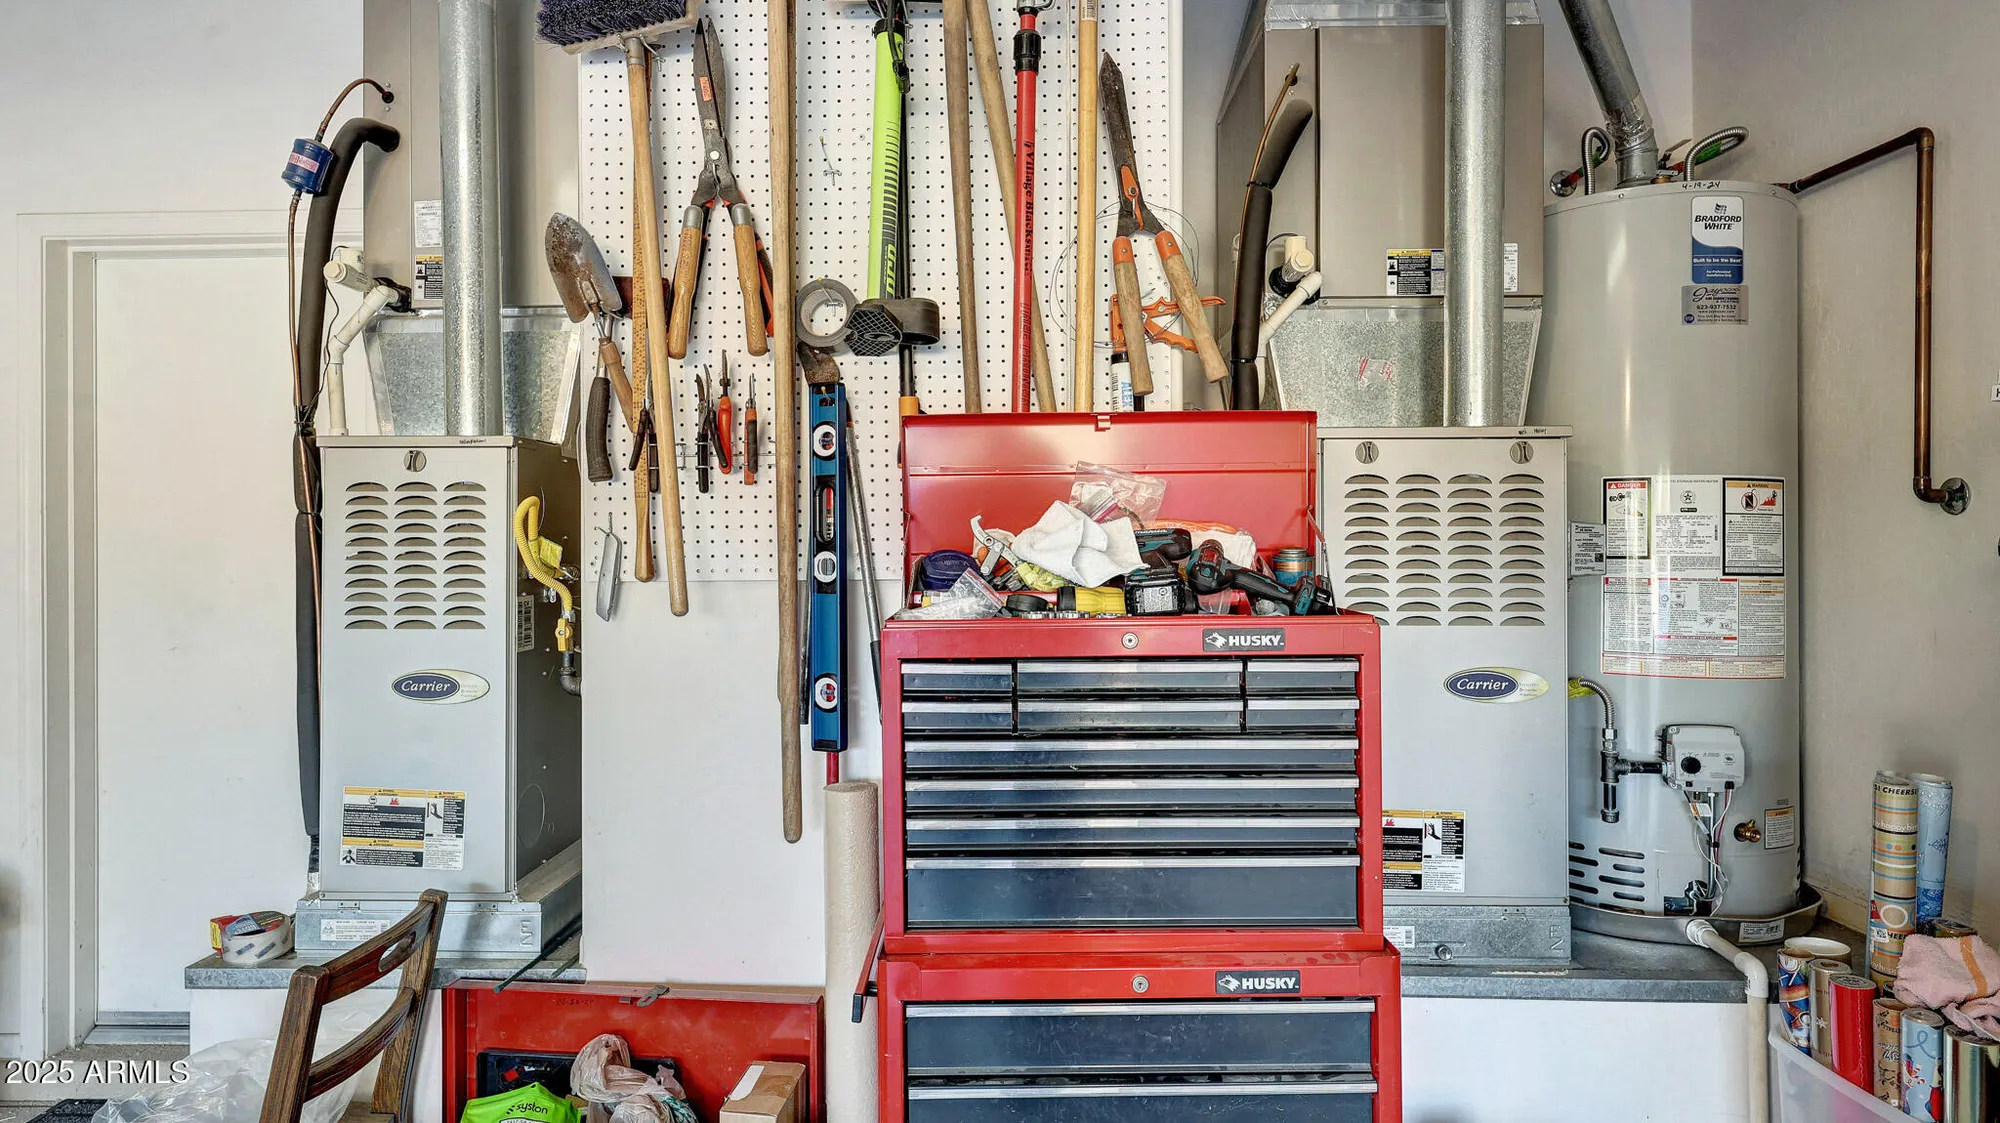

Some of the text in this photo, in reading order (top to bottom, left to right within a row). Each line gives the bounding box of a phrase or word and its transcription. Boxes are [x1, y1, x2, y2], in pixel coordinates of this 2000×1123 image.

[1022, 151, 1035, 197] Village
[1694, 215, 1742, 223] BRADFORD
[1704, 222, 1733, 231] WHITE
[1121, 381, 1132, 407] ALEX
[1228, 635, 1282, 646] HUSKY
[401, 680, 450, 691] Carrier
[1457, 678, 1508, 690] Carrier
[1241, 977, 1296, 989] HUSKY
[516, 1101, 548, 1115] syston
